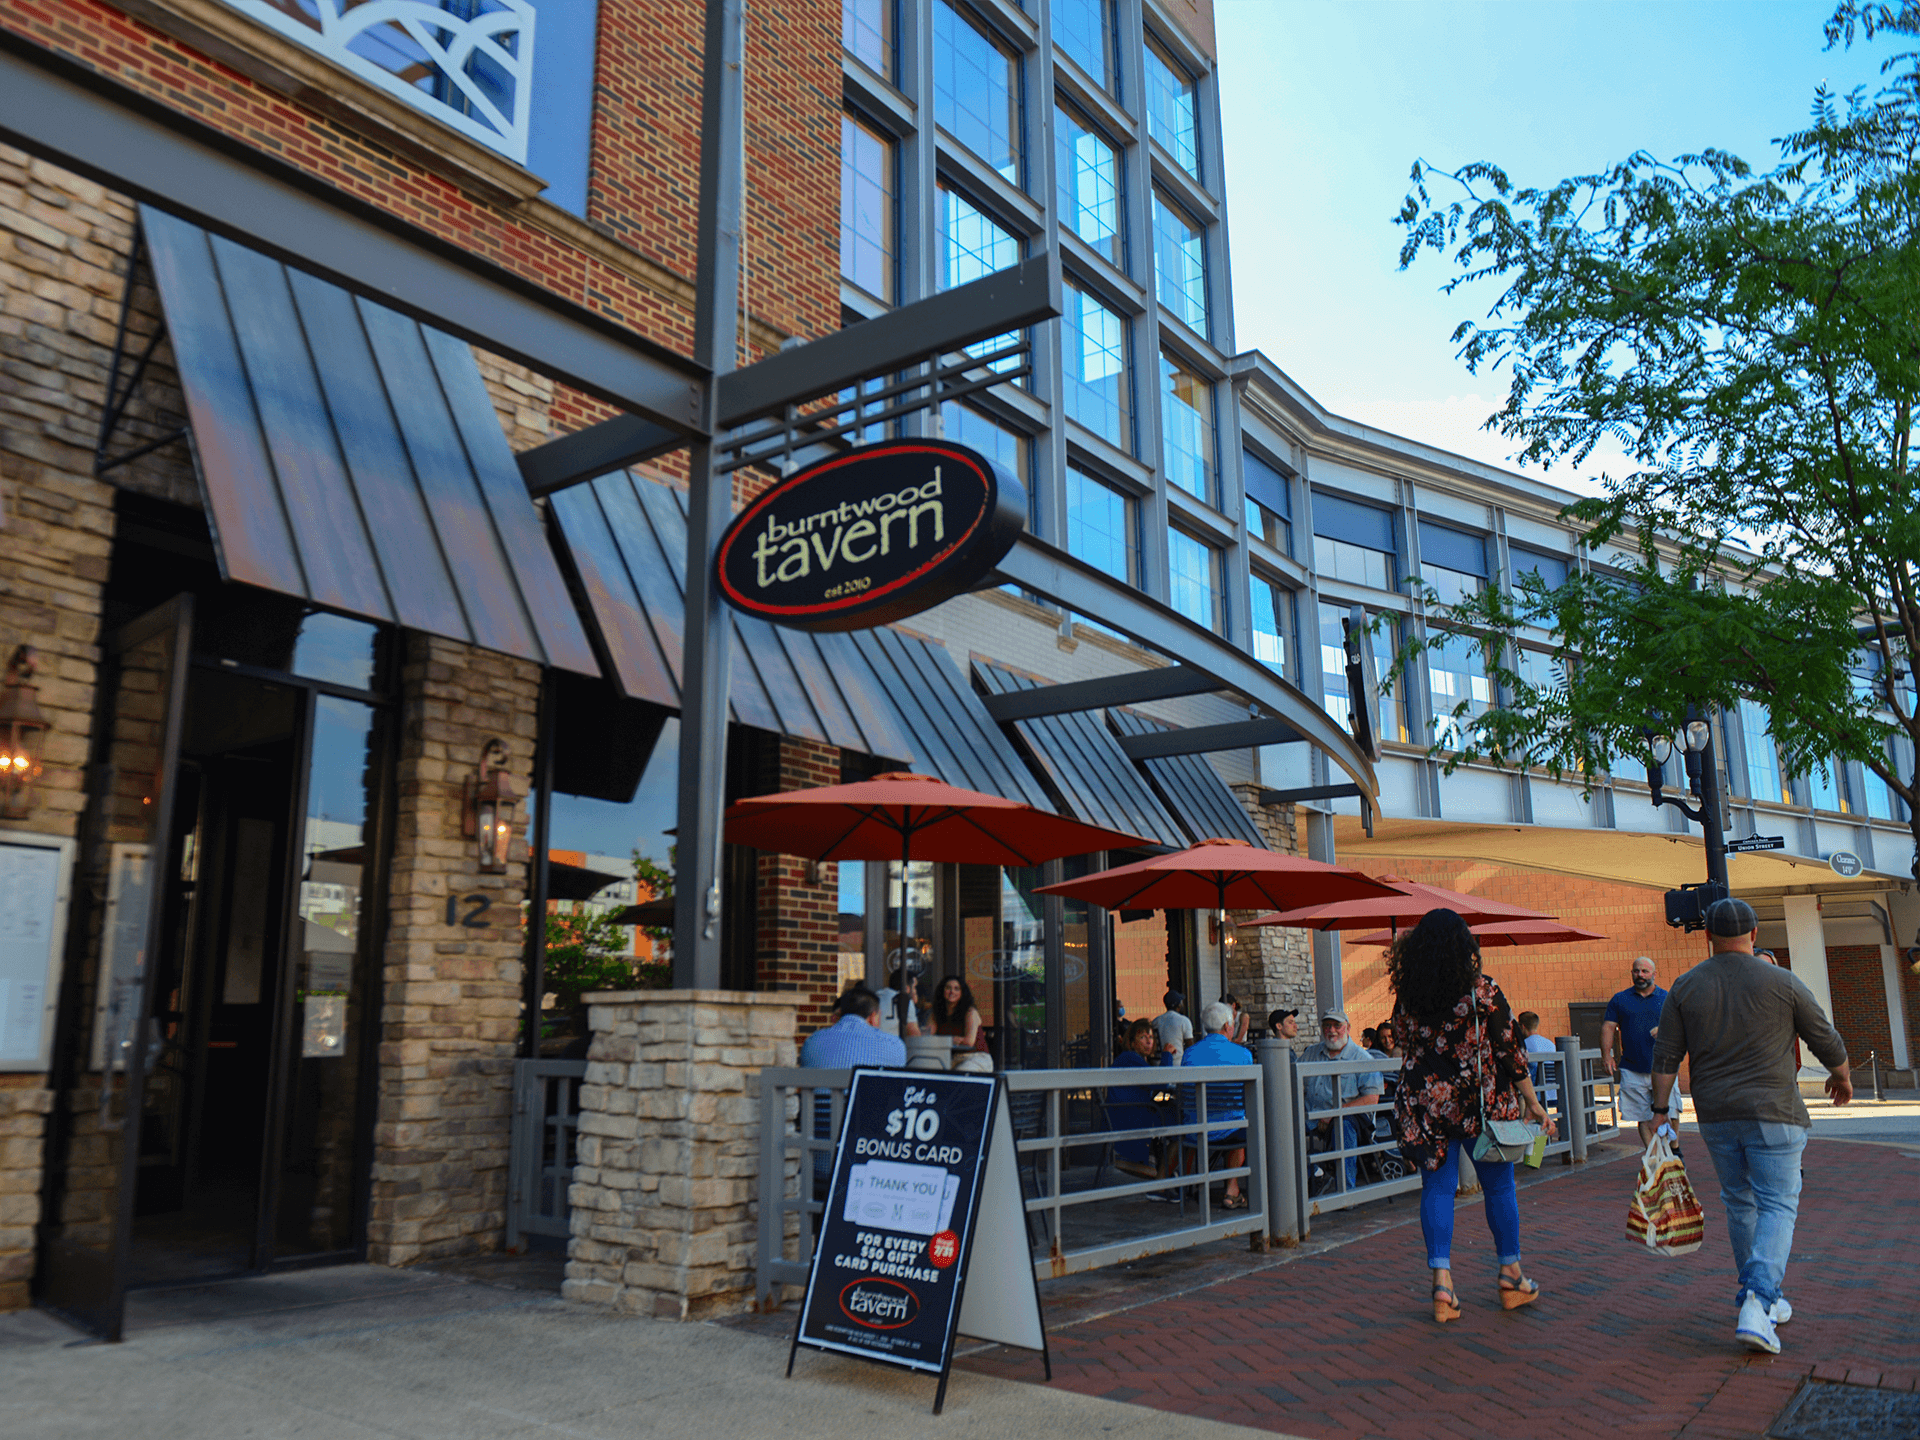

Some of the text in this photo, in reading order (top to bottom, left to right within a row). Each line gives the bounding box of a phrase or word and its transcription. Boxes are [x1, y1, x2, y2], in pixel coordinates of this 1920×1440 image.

[767, 465, 942, 542] burntwood
[752, 500, 944, 587] tavern
[844, 576, 871, 594] 2010
[445, 894, 491, 928] 12
[903, 1086, 938, 1108] Get a
[885, 1107, 940, 1142] $10
[855, 1137, 963, 1165] BONUS CARD
[870, 1176, 908, 1192] THANK
[912, 1181, 938, 1196] YOU
[856, 1231, 882, 1247] FOR
[884, 1236, 927, 1254] EVERY
[834, 1254, 940, 1283] CARD PURCHASE
[887, 1250, 918, 1266] GIFT
[850, 1290, 908, 1320] tavern
